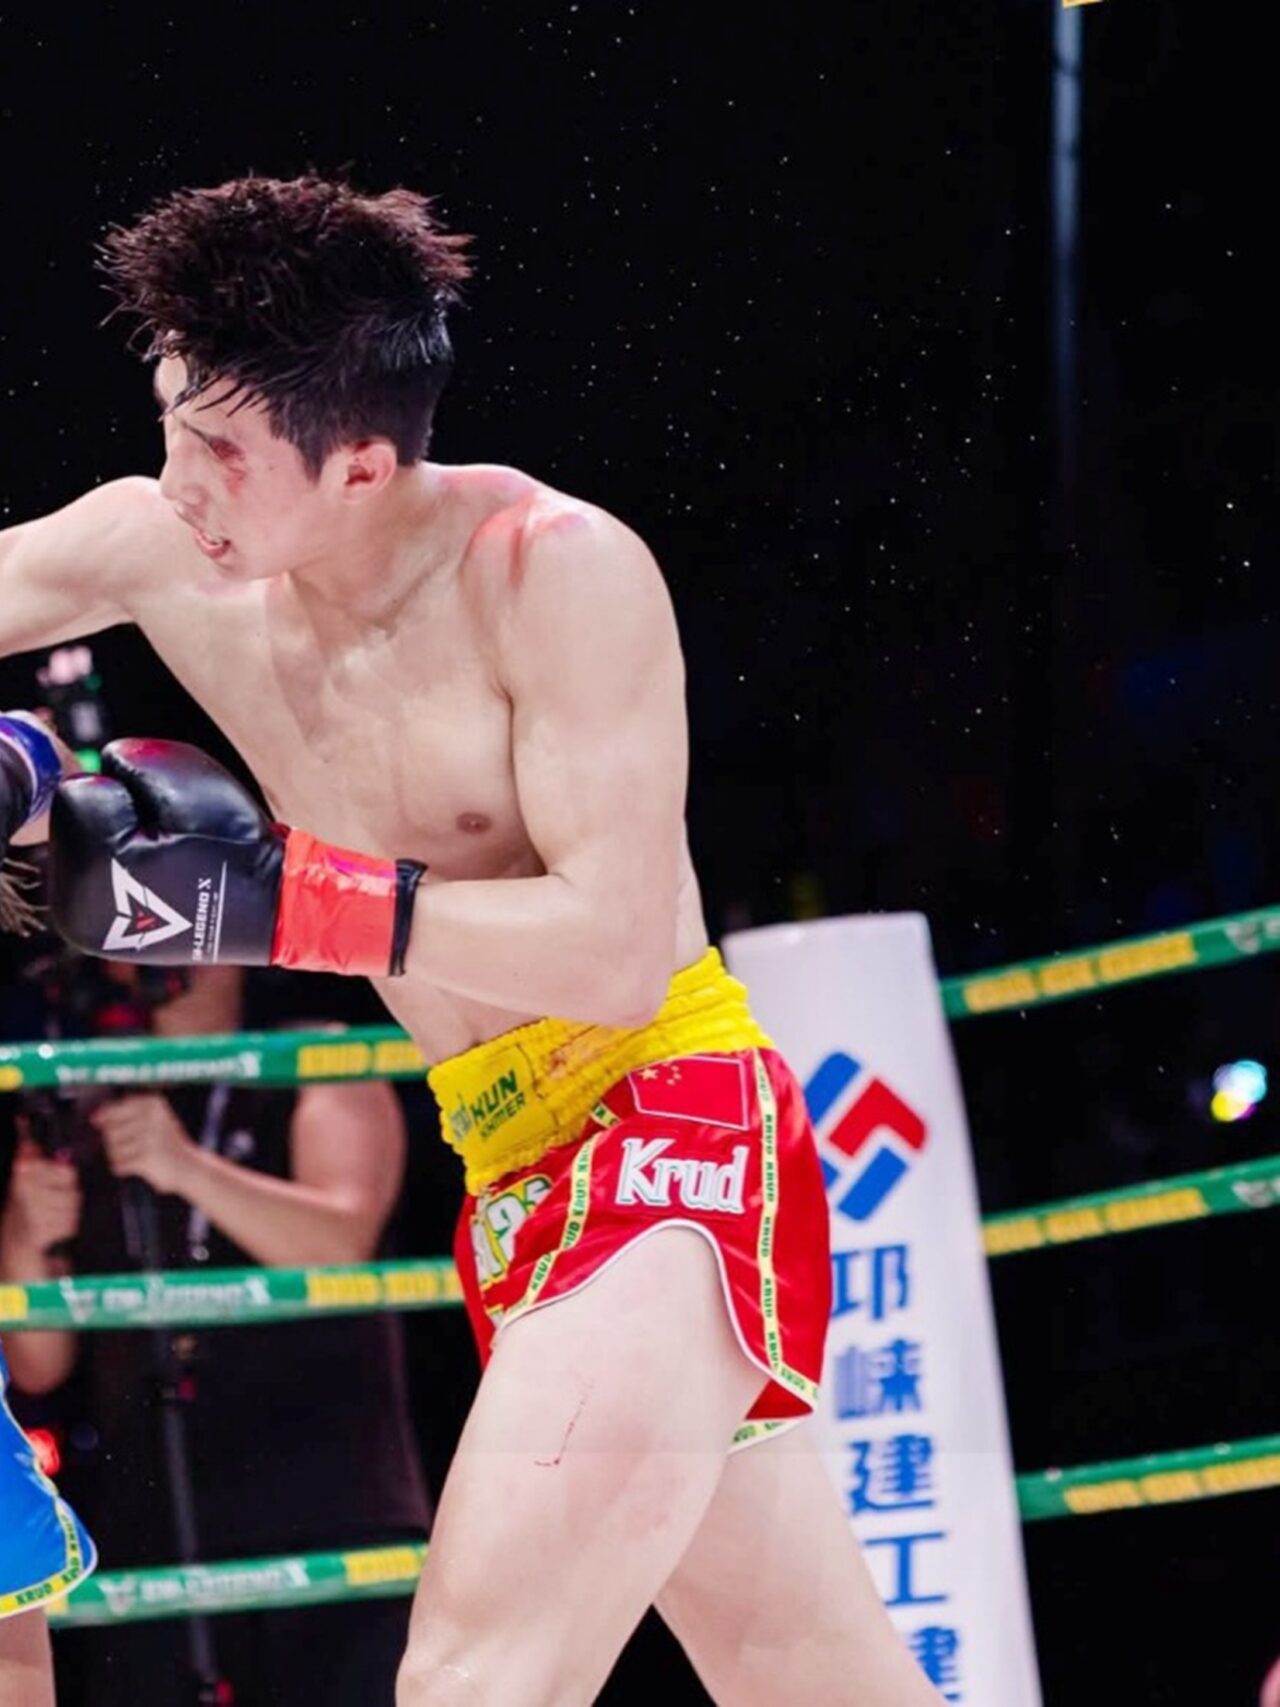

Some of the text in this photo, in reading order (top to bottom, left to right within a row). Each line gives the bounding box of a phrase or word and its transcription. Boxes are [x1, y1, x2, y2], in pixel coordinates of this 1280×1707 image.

[469, 1068, 518, 1128] KUN
[614, 1137, 750, 1215] Krud
[15, 1583, 53, 1605] KRUD
